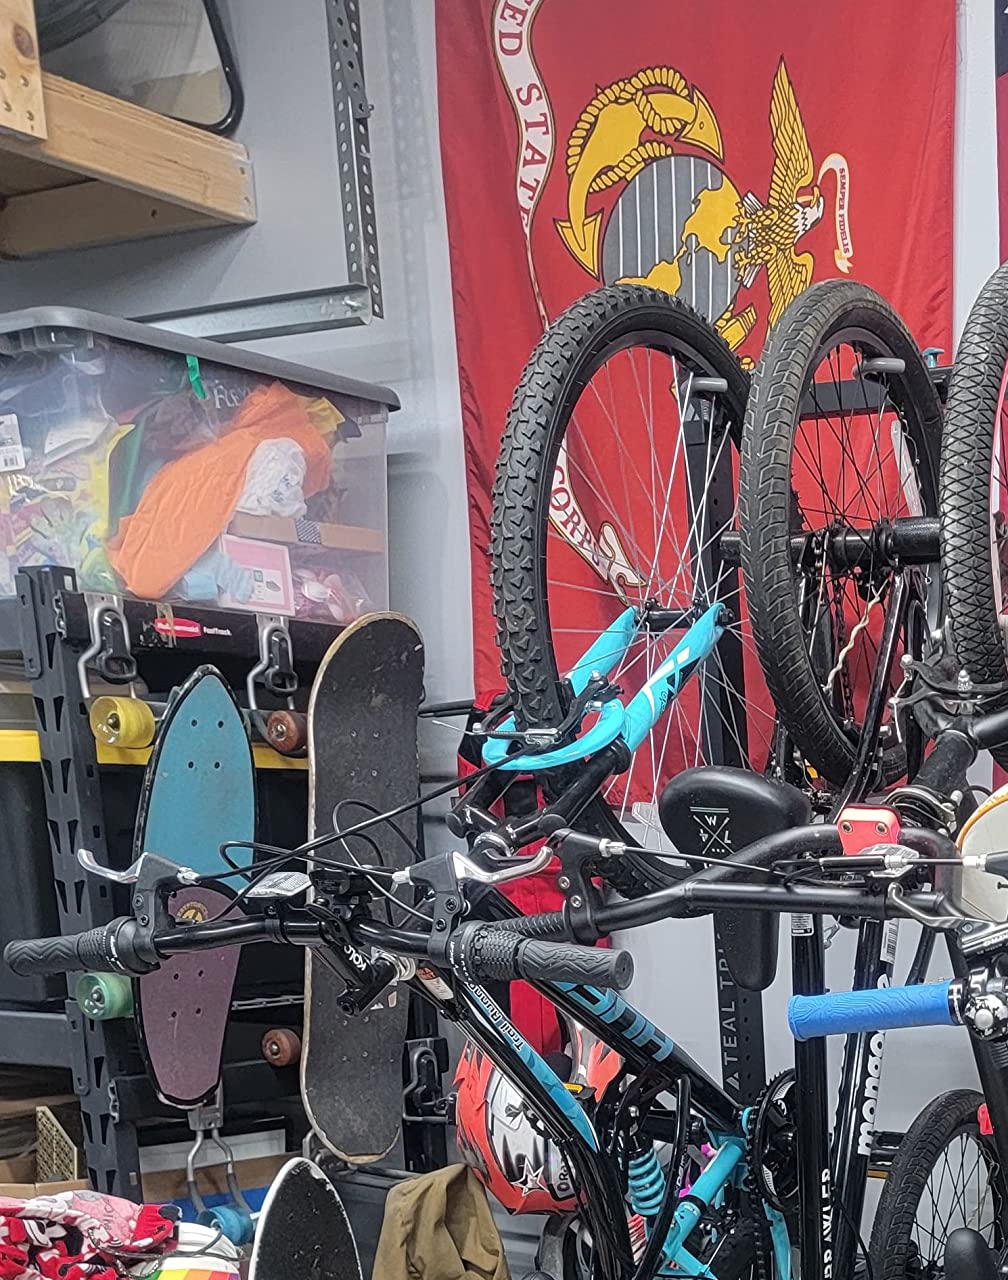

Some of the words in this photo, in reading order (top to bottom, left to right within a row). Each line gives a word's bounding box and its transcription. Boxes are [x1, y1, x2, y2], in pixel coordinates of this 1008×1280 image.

[499, 0, 532, 56] ED
[515, 82, 550, 236] STATE
[838, 167, 847, 212] SEMPER
[838, 213, 850, 254] FIDELIS
[465, 980, 504, 1025] Runne
[499, 1020, 526, 1051] Trail
[721, 1000, 738, 1066] TEAL
[857, 973, 890, 1155] mongoe
